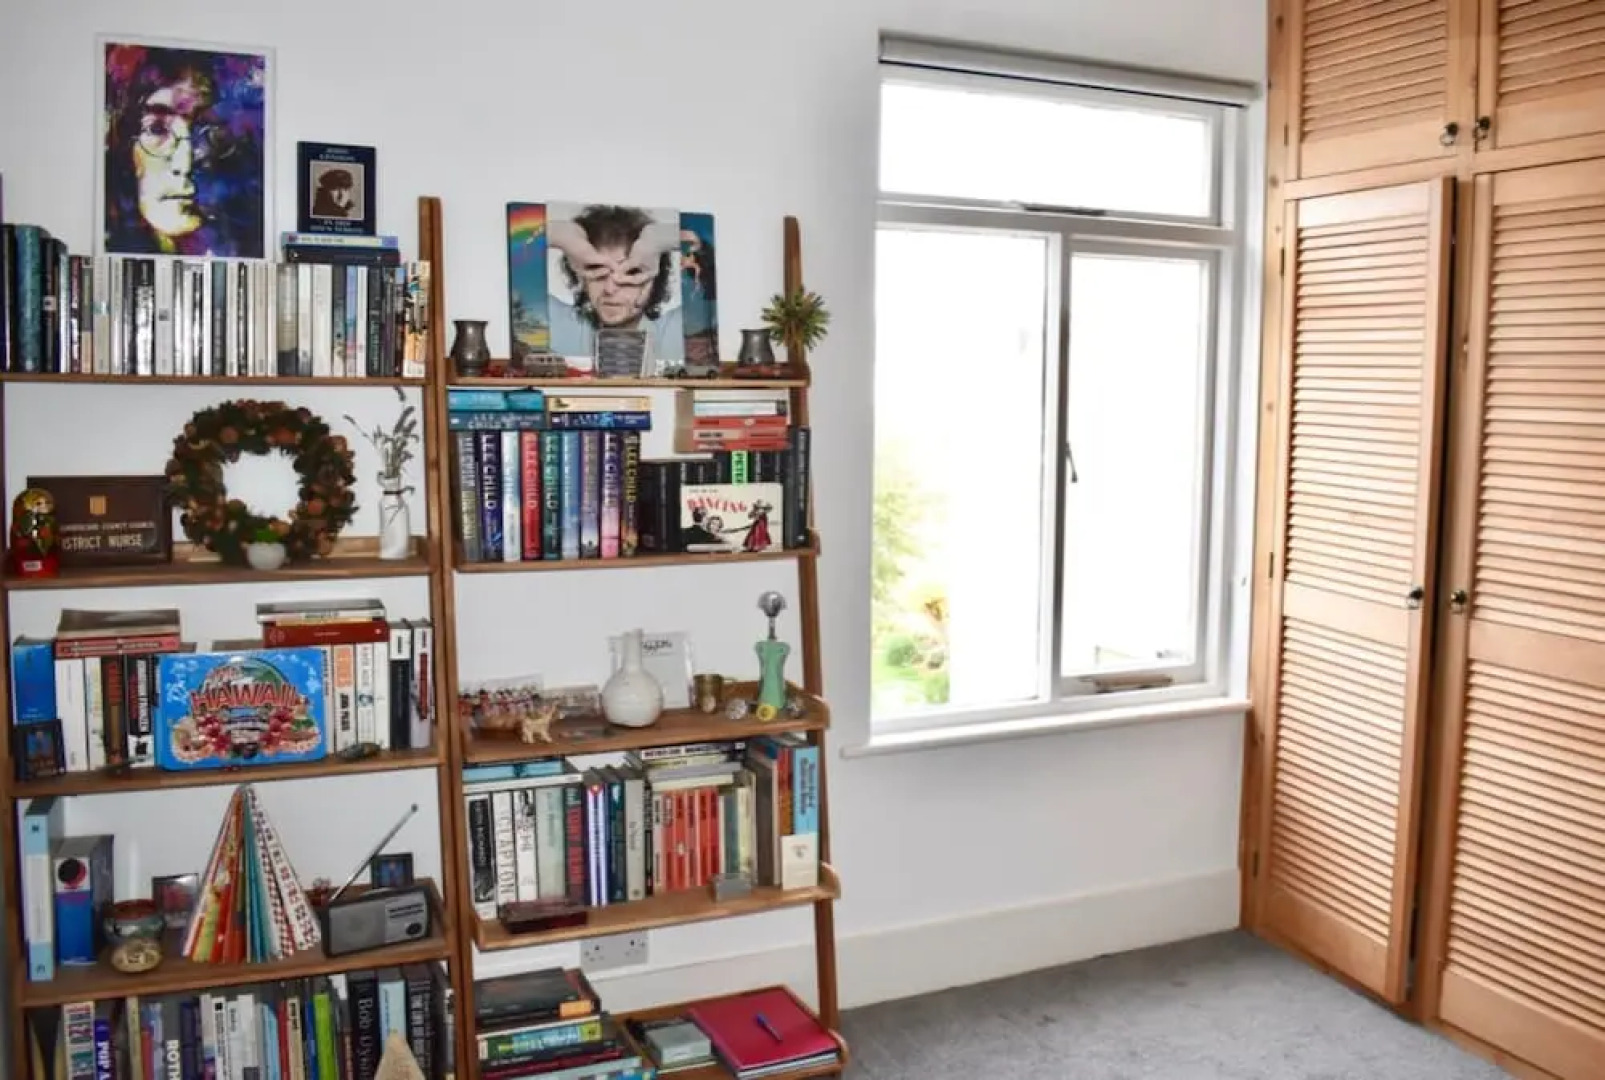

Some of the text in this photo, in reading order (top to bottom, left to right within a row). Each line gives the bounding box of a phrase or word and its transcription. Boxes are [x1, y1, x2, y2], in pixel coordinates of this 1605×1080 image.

[481, 434, 496, 510] LEE CHILD
[526, 470, 539, 509] CHILD
[545, 435, 558, 509] LEE CHILD
[604, 434, 617, 507] LEE CHILD
[625, 447, 637, 502] LEE CHILD
[686, 496, 747, 513] DANCING
[61, 533, 142, 550] ISTRICT NURSE
[191, 682, 297, 709] HAWAII
[500, 814, 515, 894] CLAPTON
[358, 998, 373, 1029] Bob
[97, 1041, 110, 1069] POP
